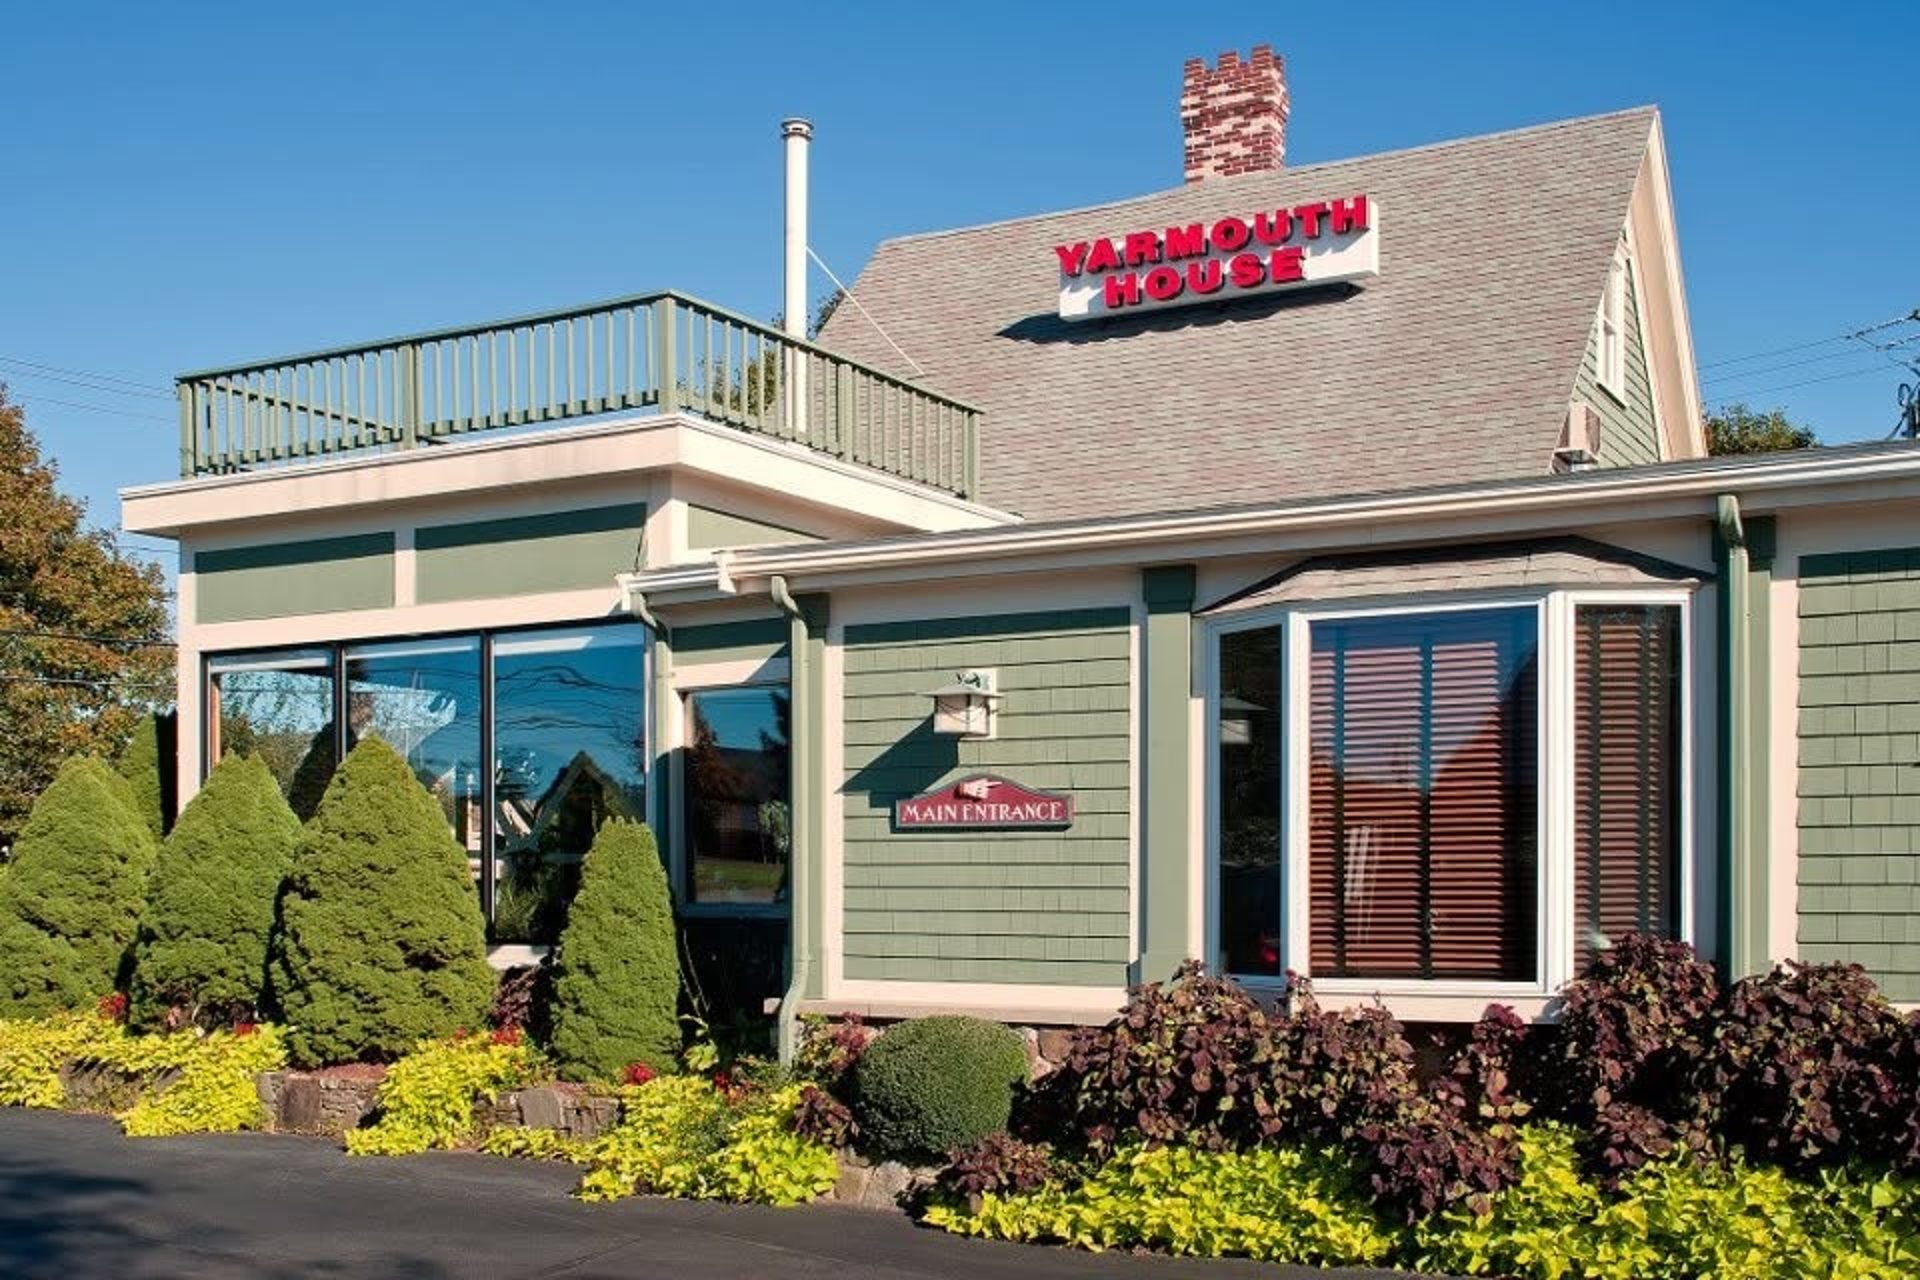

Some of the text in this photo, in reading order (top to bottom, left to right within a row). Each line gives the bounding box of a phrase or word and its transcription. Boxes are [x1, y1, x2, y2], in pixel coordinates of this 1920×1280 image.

[1055, 194, 1369, 276] YARMOUTH
[1104, 246, 1306, 308] HOUSE
[902, 802, 1063, 822] MAIN ENTRANCE
